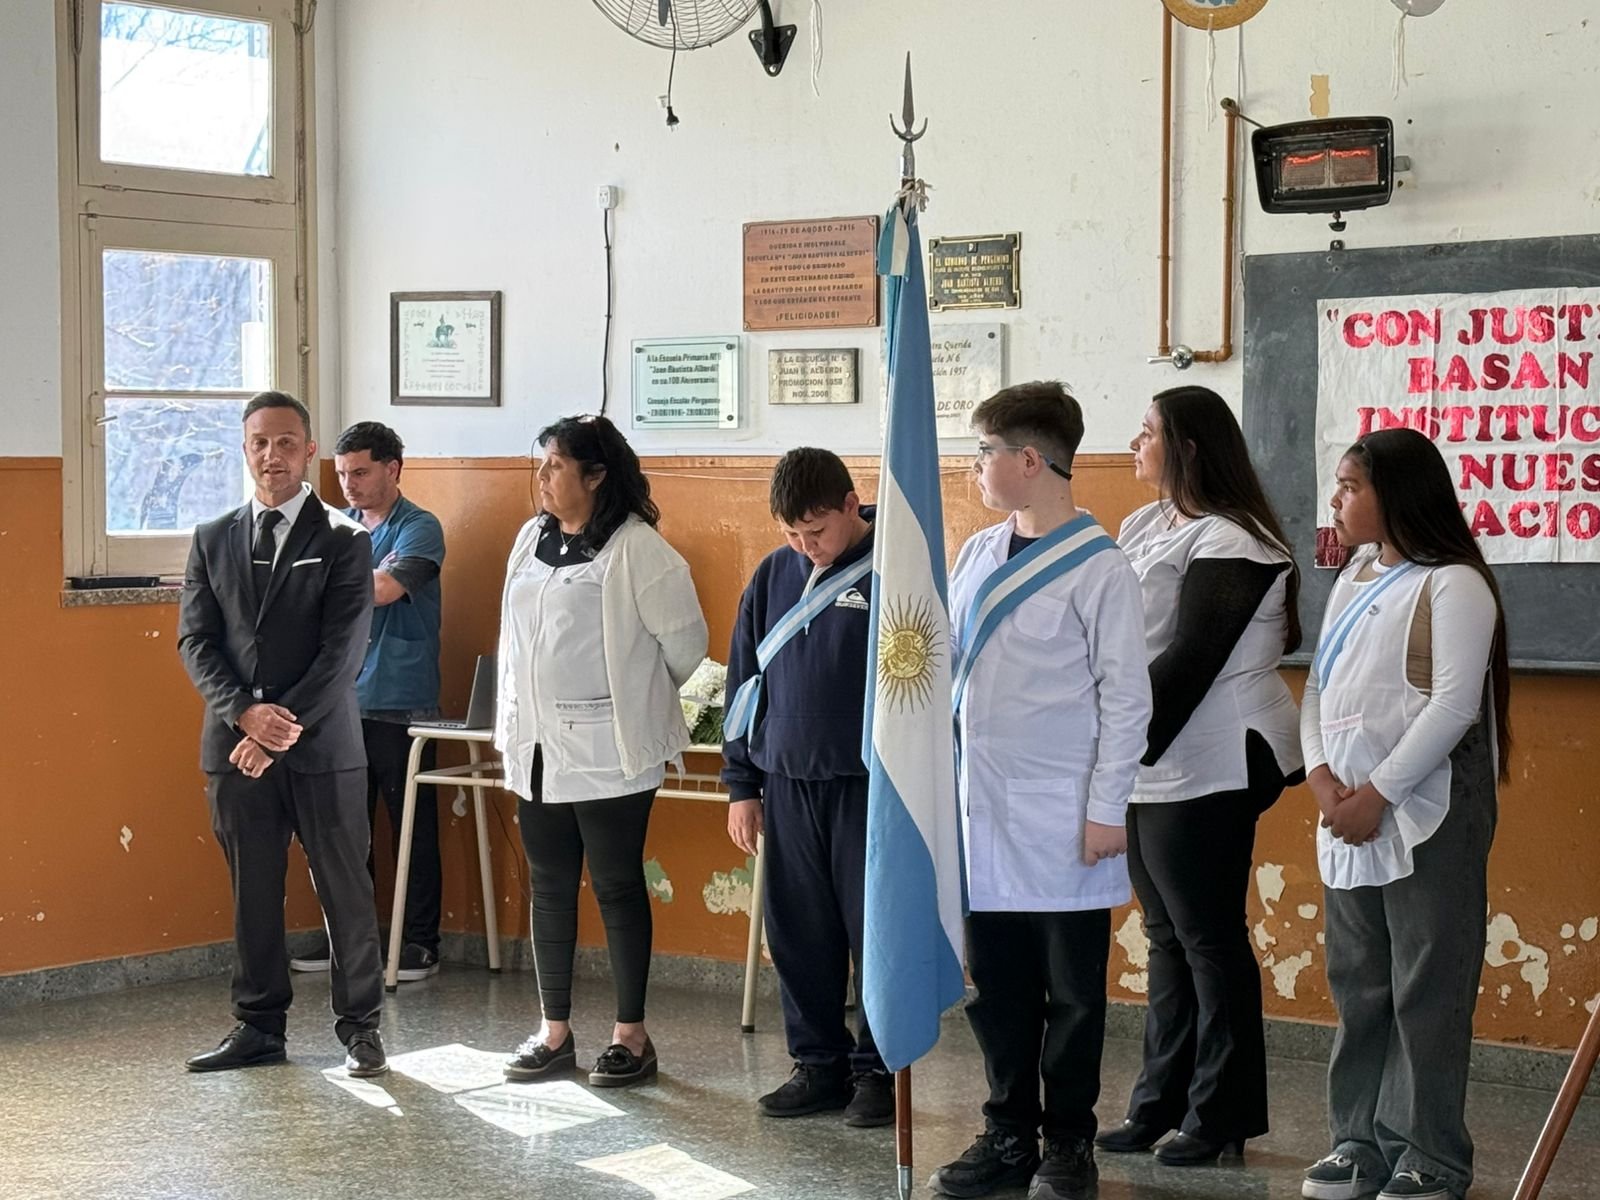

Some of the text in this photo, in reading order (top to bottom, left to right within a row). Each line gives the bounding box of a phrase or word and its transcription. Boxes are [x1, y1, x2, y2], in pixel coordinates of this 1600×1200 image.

[762, 286, 793, 294] GRATITUD
[776, 311, 840, 321] ¡FELICIDADES!
[1326, 304, 1600, 348] "CON JUST
[944, 340, 971, 350] Querida
[779, 367, 798, 375] JUAN
[810, 366, 842, 374] ALBERDI
[949, 367, 967, 376] 1957
[1408, 352, 1594, 393] BASAN
[937, 400, 974, 411] DE ORO
[1357, 405, 1600, 442] INSTITUC
[1459, 454, 1600, 491] NUES
[1458, 500, 1600, 540] ACIO
